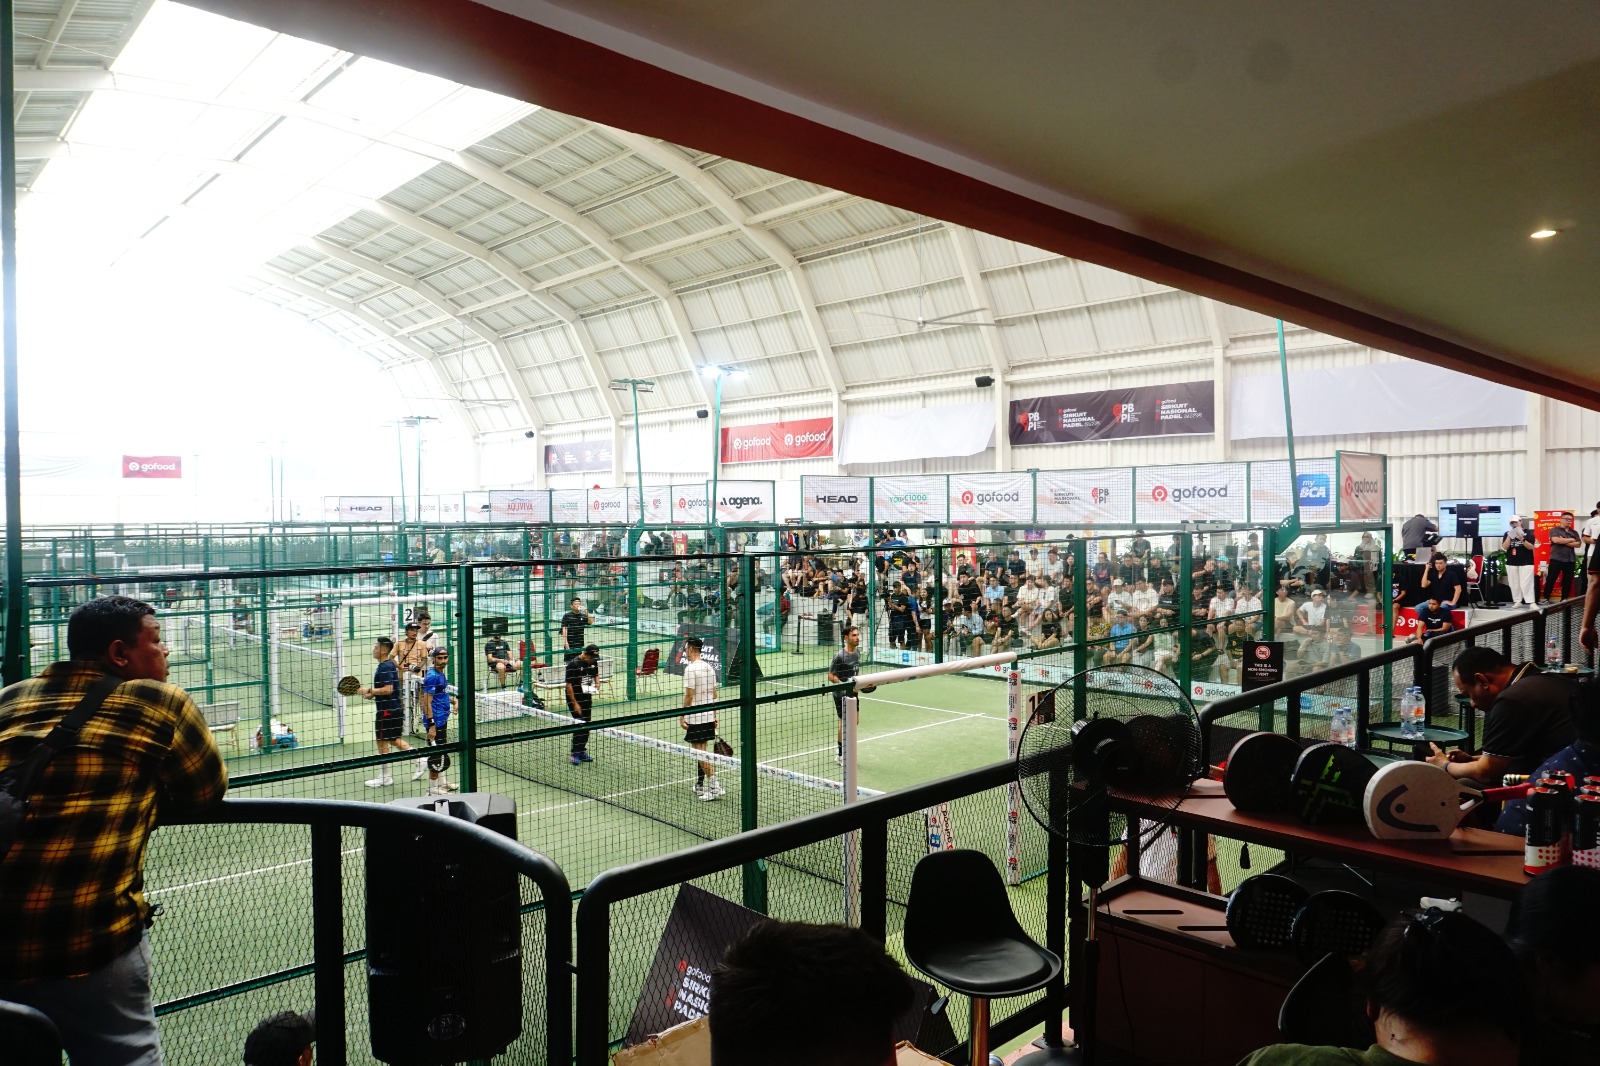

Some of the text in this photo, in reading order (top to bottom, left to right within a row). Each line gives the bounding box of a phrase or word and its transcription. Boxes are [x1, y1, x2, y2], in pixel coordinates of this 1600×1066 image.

[1121, 403, 1134, 414] PB
[1028, 412, 1040, 421] PB
[1121, 413, 1130, 423] PI
[1028, 422, 1037, 431] PI
[743, 436, 771, 449] gofood
[795, 431, 826, 445] gofood
[141, 463, 176, 472] gofood
[1098, 488, 1109, 496] PB
[1300, 486, 1327, 498] BCA
[1354, 478, 1378, 497] gofood
[816, 495, 858, 503] HEAD
[977, 491, 1019, 505] gofood
[1172, 485, 1228, 502] gofood
[601, 501, 620, 510] gofood
[688, 498, 707, 509] gofoo
[729, 496, 763, 509] agena.
[1098, 496, 1107, 504] PI
[405, 609, 413, 621] 2
[1205, 688, 1236, 697] gofood
[686, 966, 712, 983] gofood
